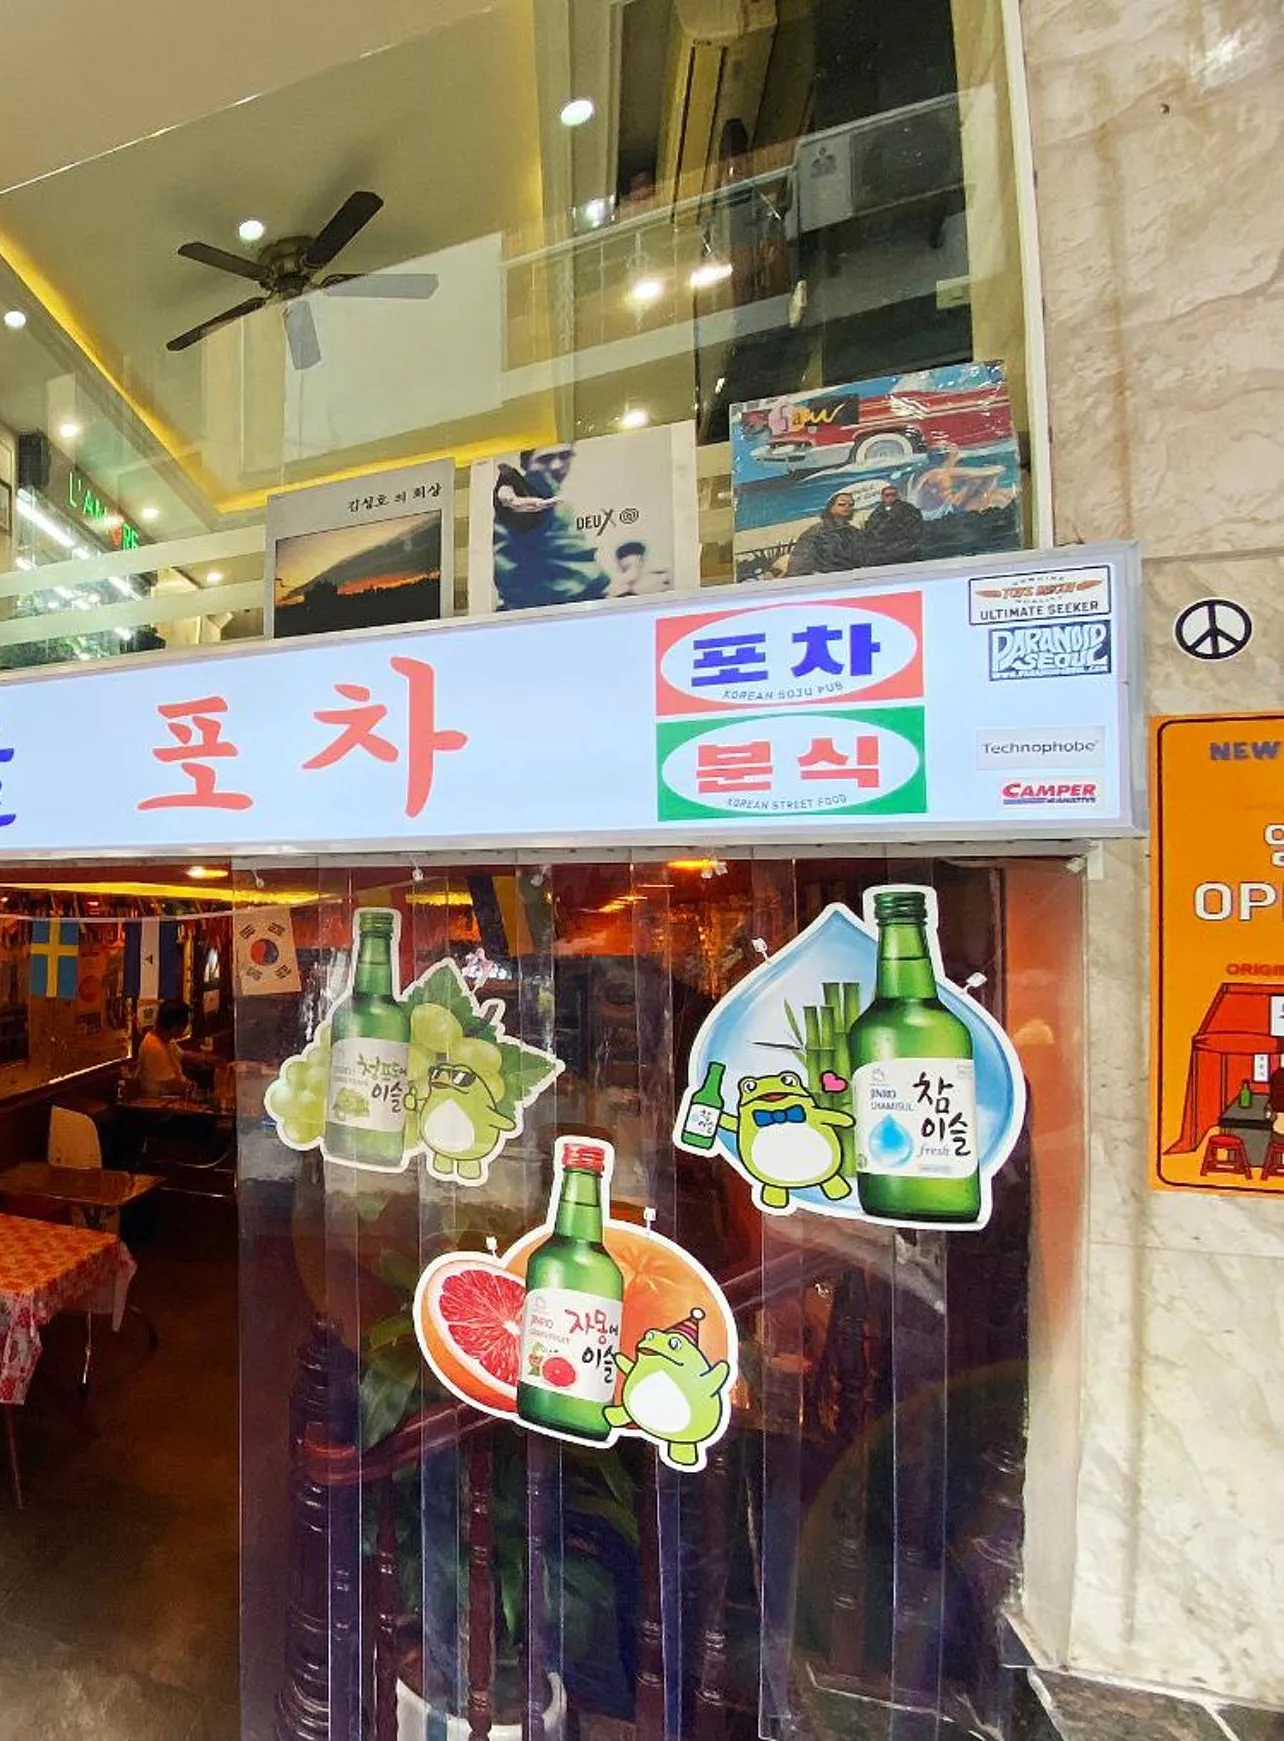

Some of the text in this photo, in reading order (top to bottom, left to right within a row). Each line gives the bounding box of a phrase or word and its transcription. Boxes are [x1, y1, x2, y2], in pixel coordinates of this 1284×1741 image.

[576, 508, 617, 536] DEUX
[980, 601, 1099, 620] ULTIMATE SEEKER
[691, 623, 881, 687] 포차
[991, 624, 1107, 672] PARANOID
[1012, 645, 1109, 670] SEOUL
[722, 680, 844, 701] KOREAN SOJU PUB
[136, 655, 468, 818] 포차
[981, 740, 1097, 755] Technophobe
[1209, 741, 1282, 761] NEW
[695, 735, 880, 794] 분식
[727, 793, 847, 810] KOREAN STREET FOOD
[1002, 783, 1097, 798] CAMPER
[1194, 882, 1284, 921] OP
[371, 1081, 403, 1113] 이슬
[912, 1071, 954, 1114] 참
[921, 1112, 971, 1156] 이슬
[564, 1308, 619, 1345] 자몽에
[581, 1344, 614, 1384] 이슬
